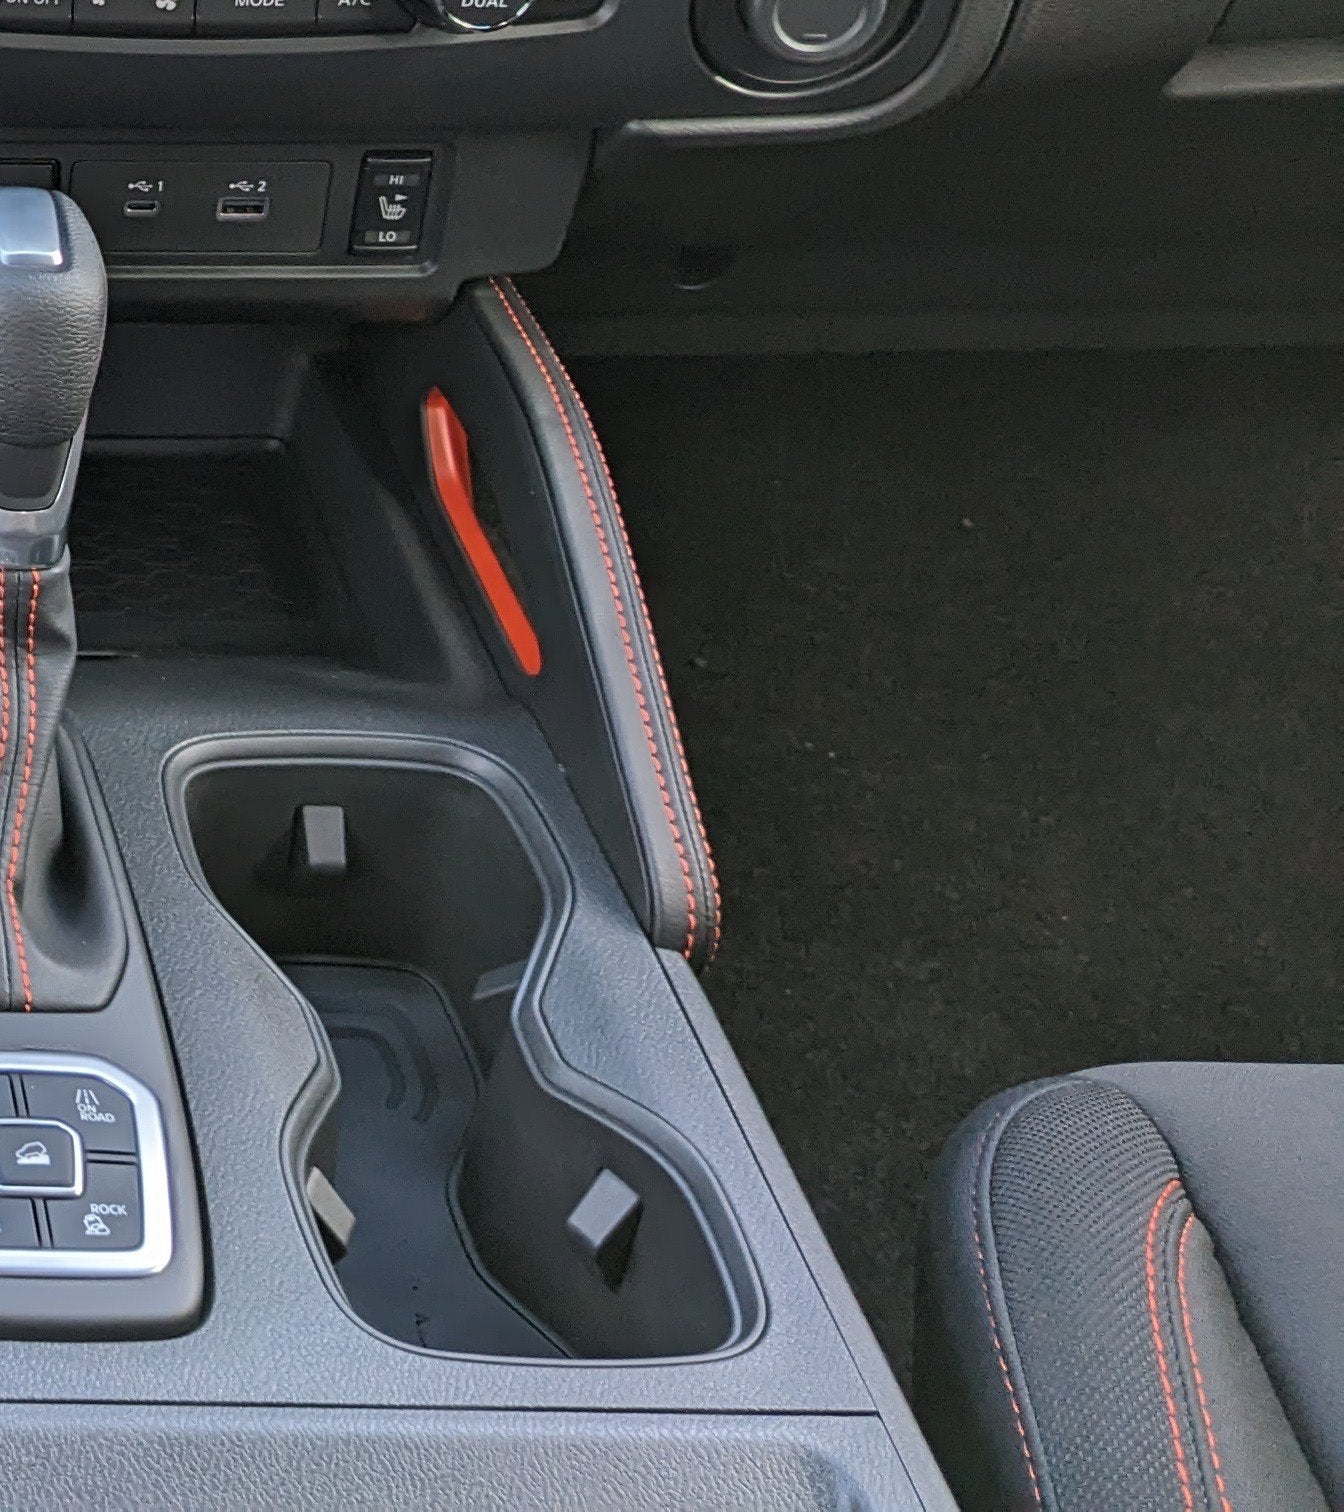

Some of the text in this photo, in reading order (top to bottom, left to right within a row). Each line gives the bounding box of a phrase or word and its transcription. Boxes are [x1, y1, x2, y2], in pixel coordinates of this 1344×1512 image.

[389, 173, 405, 185] HI
[158, 181, 165, 192] 1
[257, 180, 267, 192] 2
[377, 230, 397, 243] LO
[80, 1112, 116, 1124] ROAD
[89, 1202, 128, 1216] ROCK
